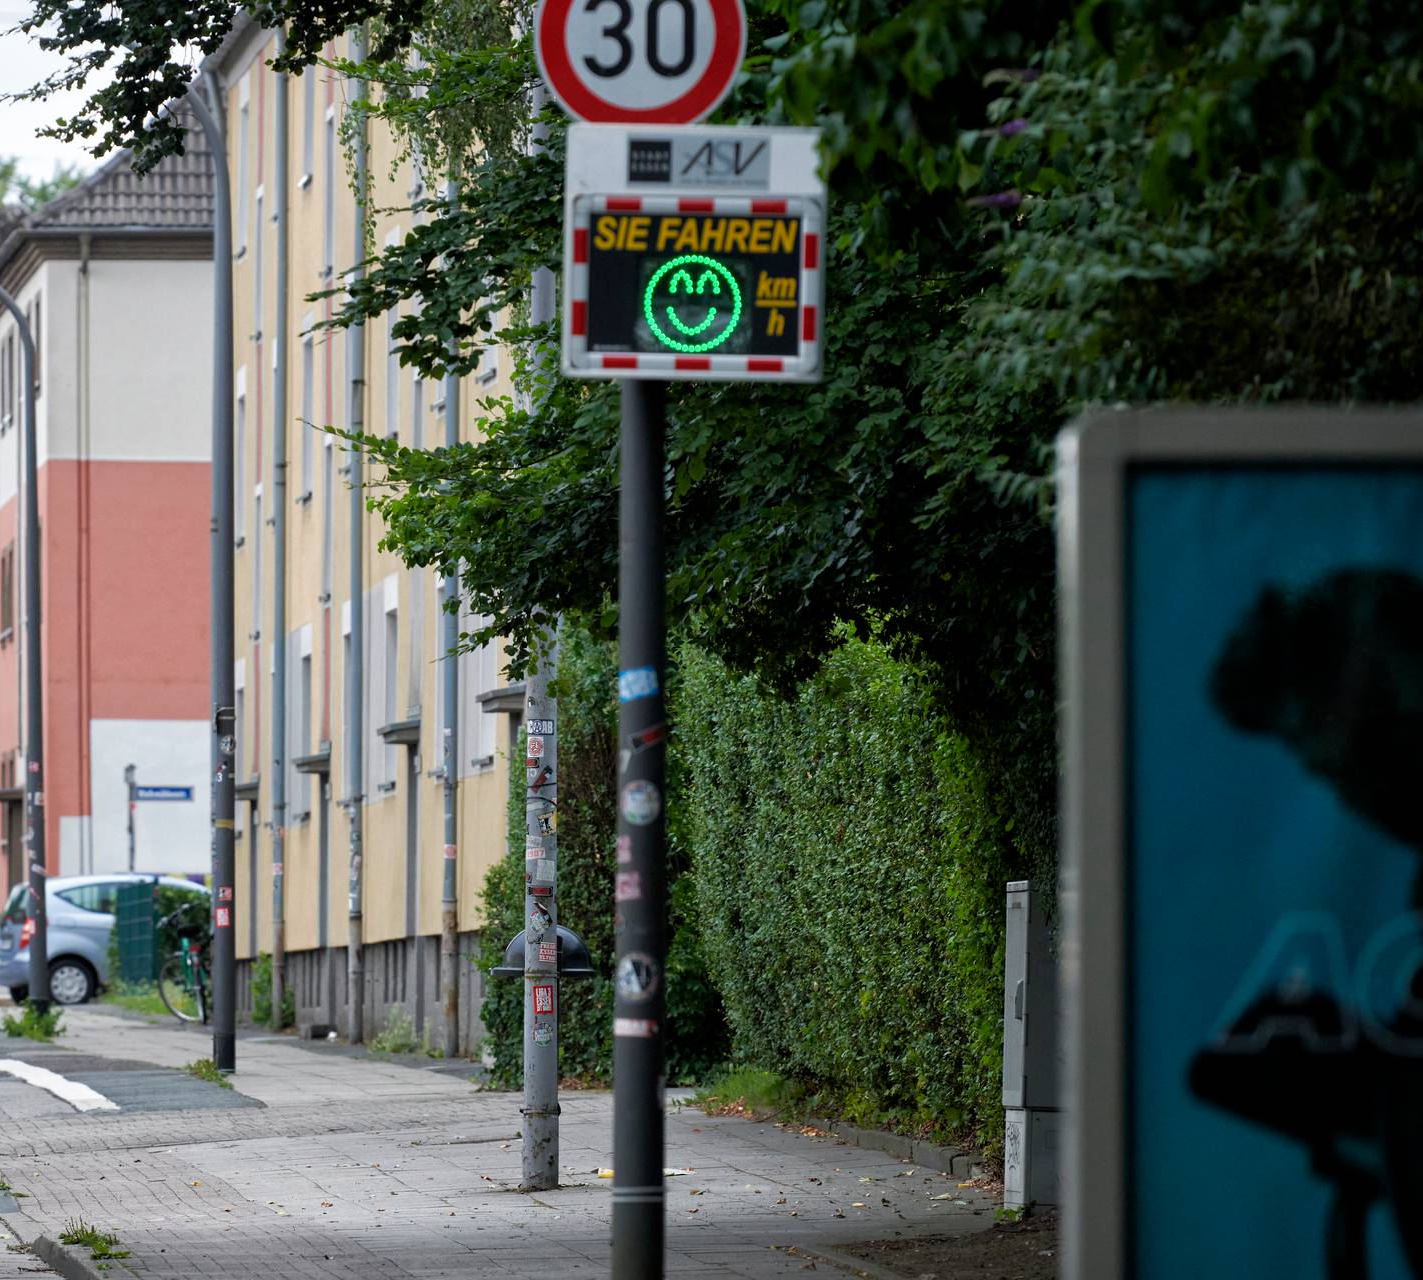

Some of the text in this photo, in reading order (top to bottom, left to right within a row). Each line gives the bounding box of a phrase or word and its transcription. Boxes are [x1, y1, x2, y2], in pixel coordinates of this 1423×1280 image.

[583, 0, 695, 77] 30
[680, 140, 767, 175] ASV
[593, 216, 798, 253] SIE FAHREN
[756, 271, 797, 299] km
[766, 309, 785, 336] h
